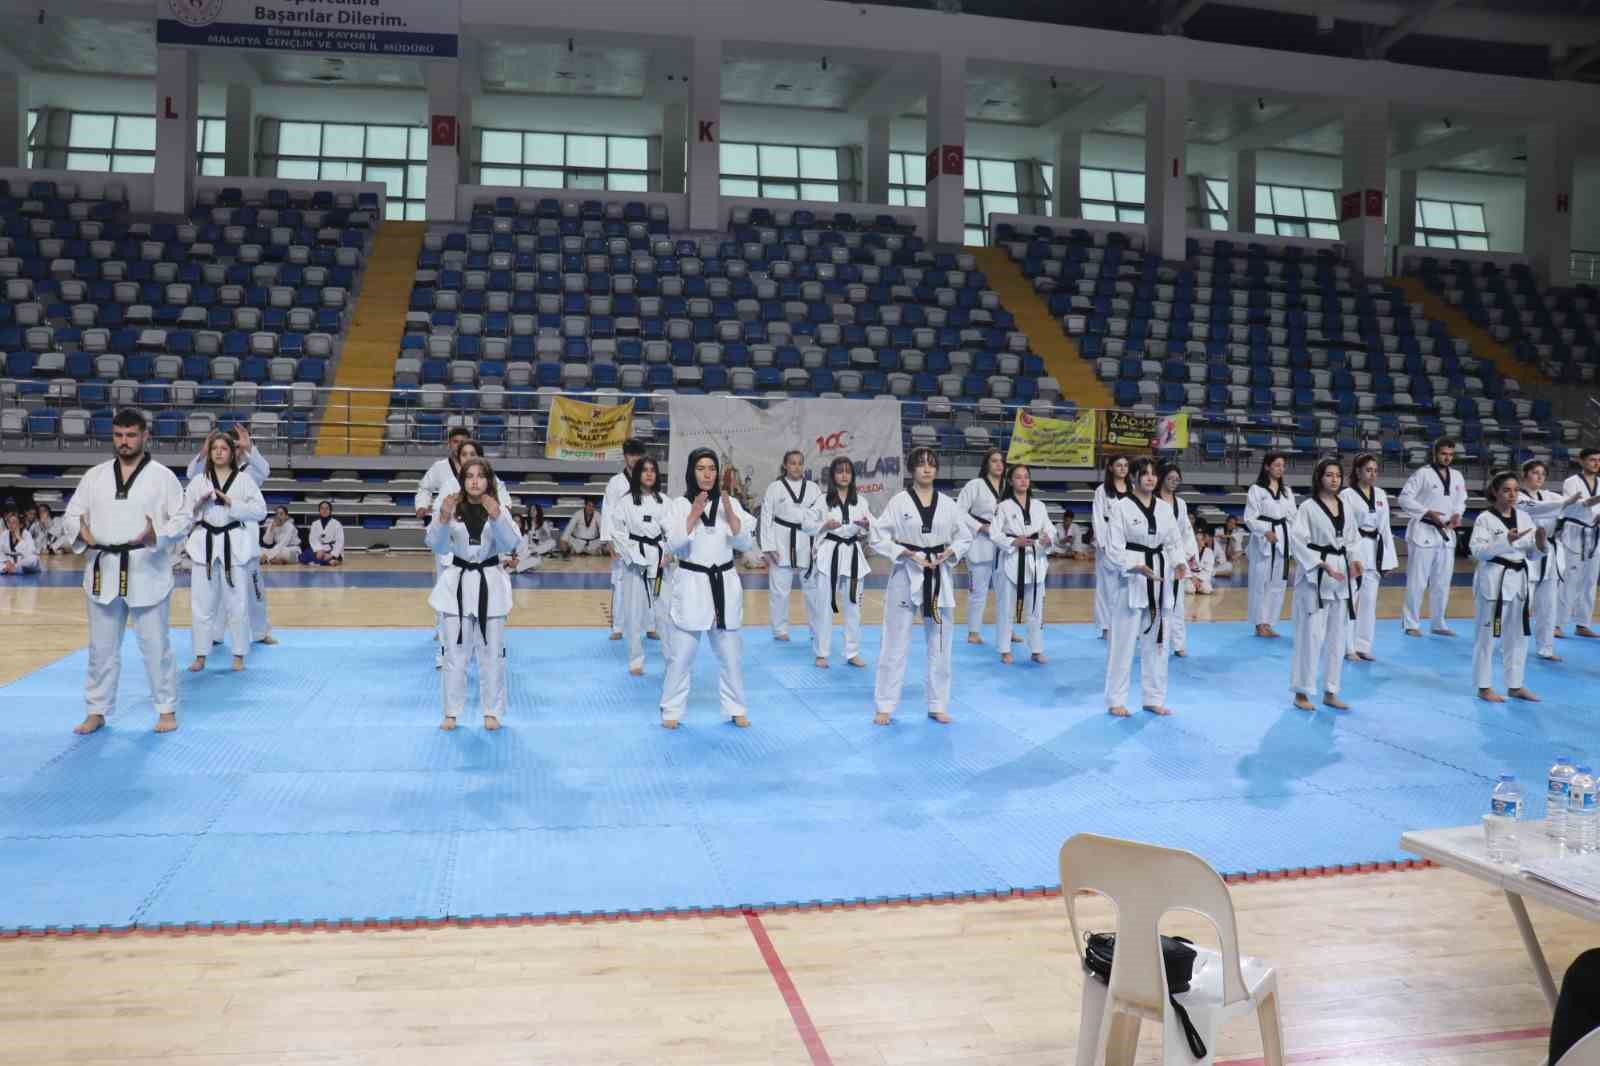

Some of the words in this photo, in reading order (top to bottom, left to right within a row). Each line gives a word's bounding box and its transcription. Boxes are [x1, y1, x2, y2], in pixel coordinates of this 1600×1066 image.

[255, 6, 333, 24] Başarılar
[337, 10, 407, 26] Dilerim.
[207, 34, 261, 46] MALATYA
[318, 41, 331, 49] VE
[335, 41, 366, 51] SPOR
[165, 95, 178, 118] L
[699, 120, 715, 141] K
[1556, 192, 1569, 213] H
